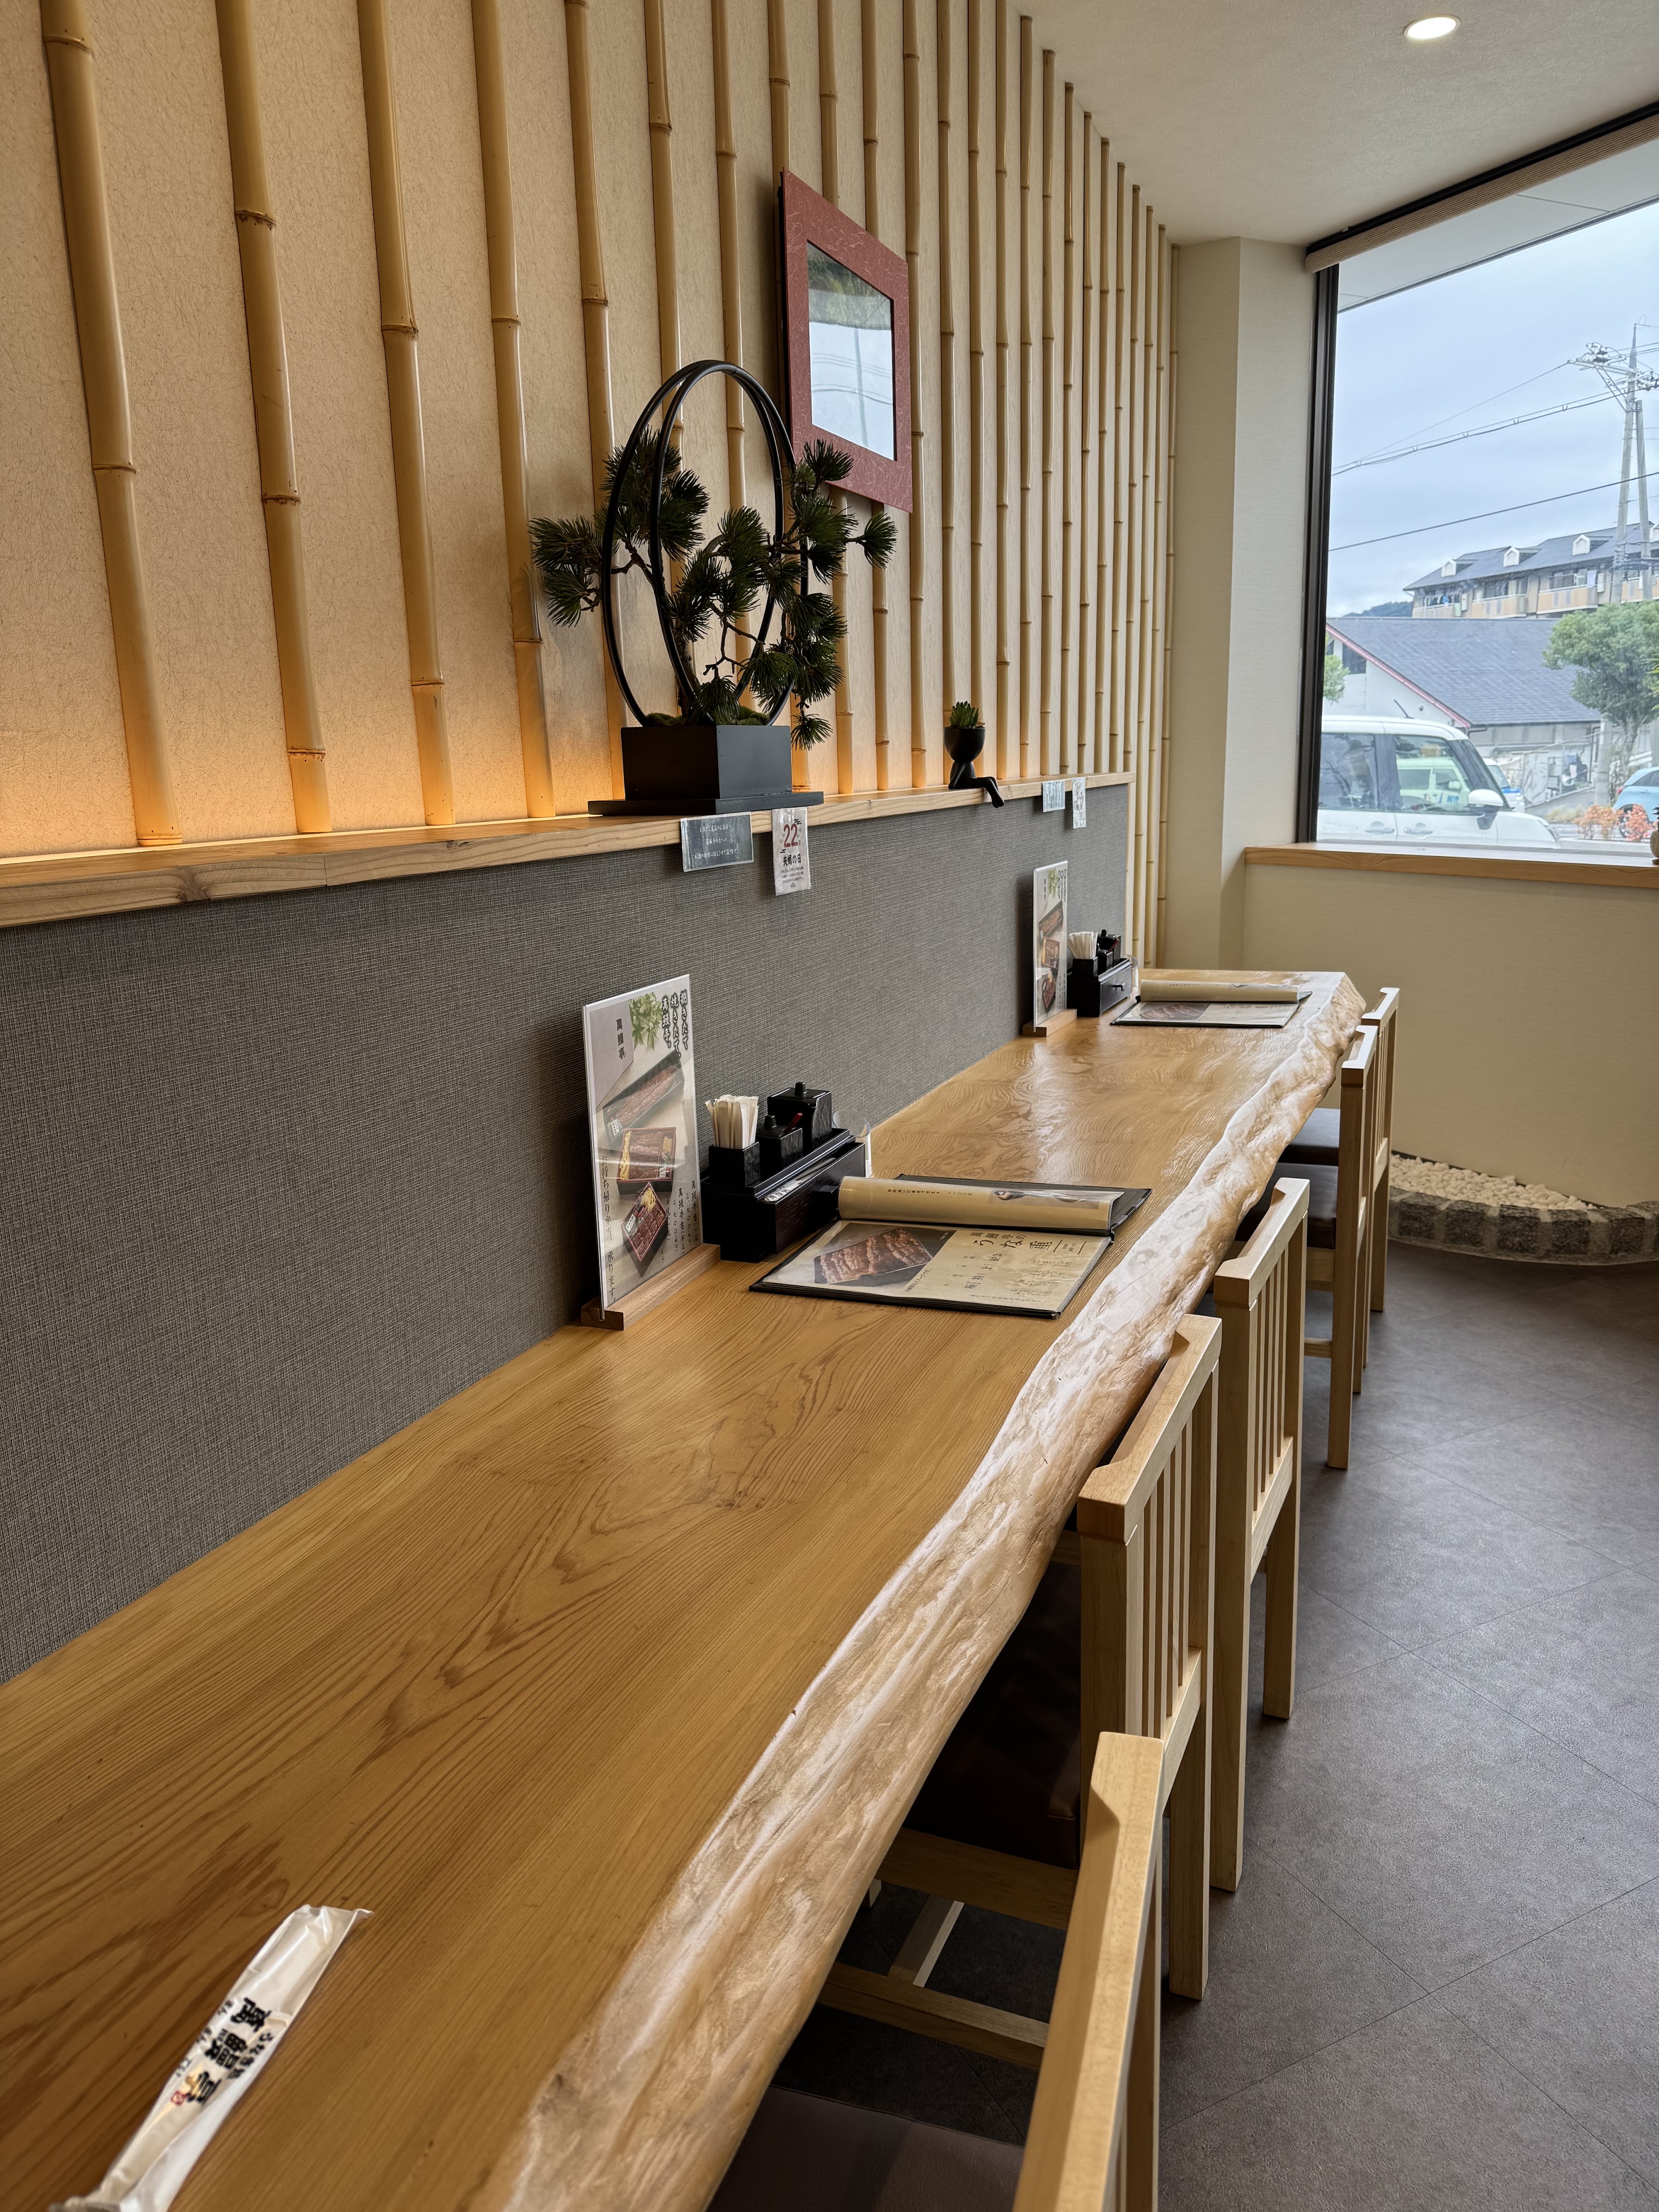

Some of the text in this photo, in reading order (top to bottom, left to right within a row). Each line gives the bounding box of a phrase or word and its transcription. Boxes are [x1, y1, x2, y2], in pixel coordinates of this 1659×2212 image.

[783, 853, 801, 866] 夫婦の日
[616, 1018, 626, 1059] 萬鰻亭
[680, 990, 688, 1050] 捌きたて
[972, 1240, 1053, 1250] うな重
[185, 1997, 272, 2105] 萬鰻亭
[227, 2032, 275, 2079] うなぎ処
